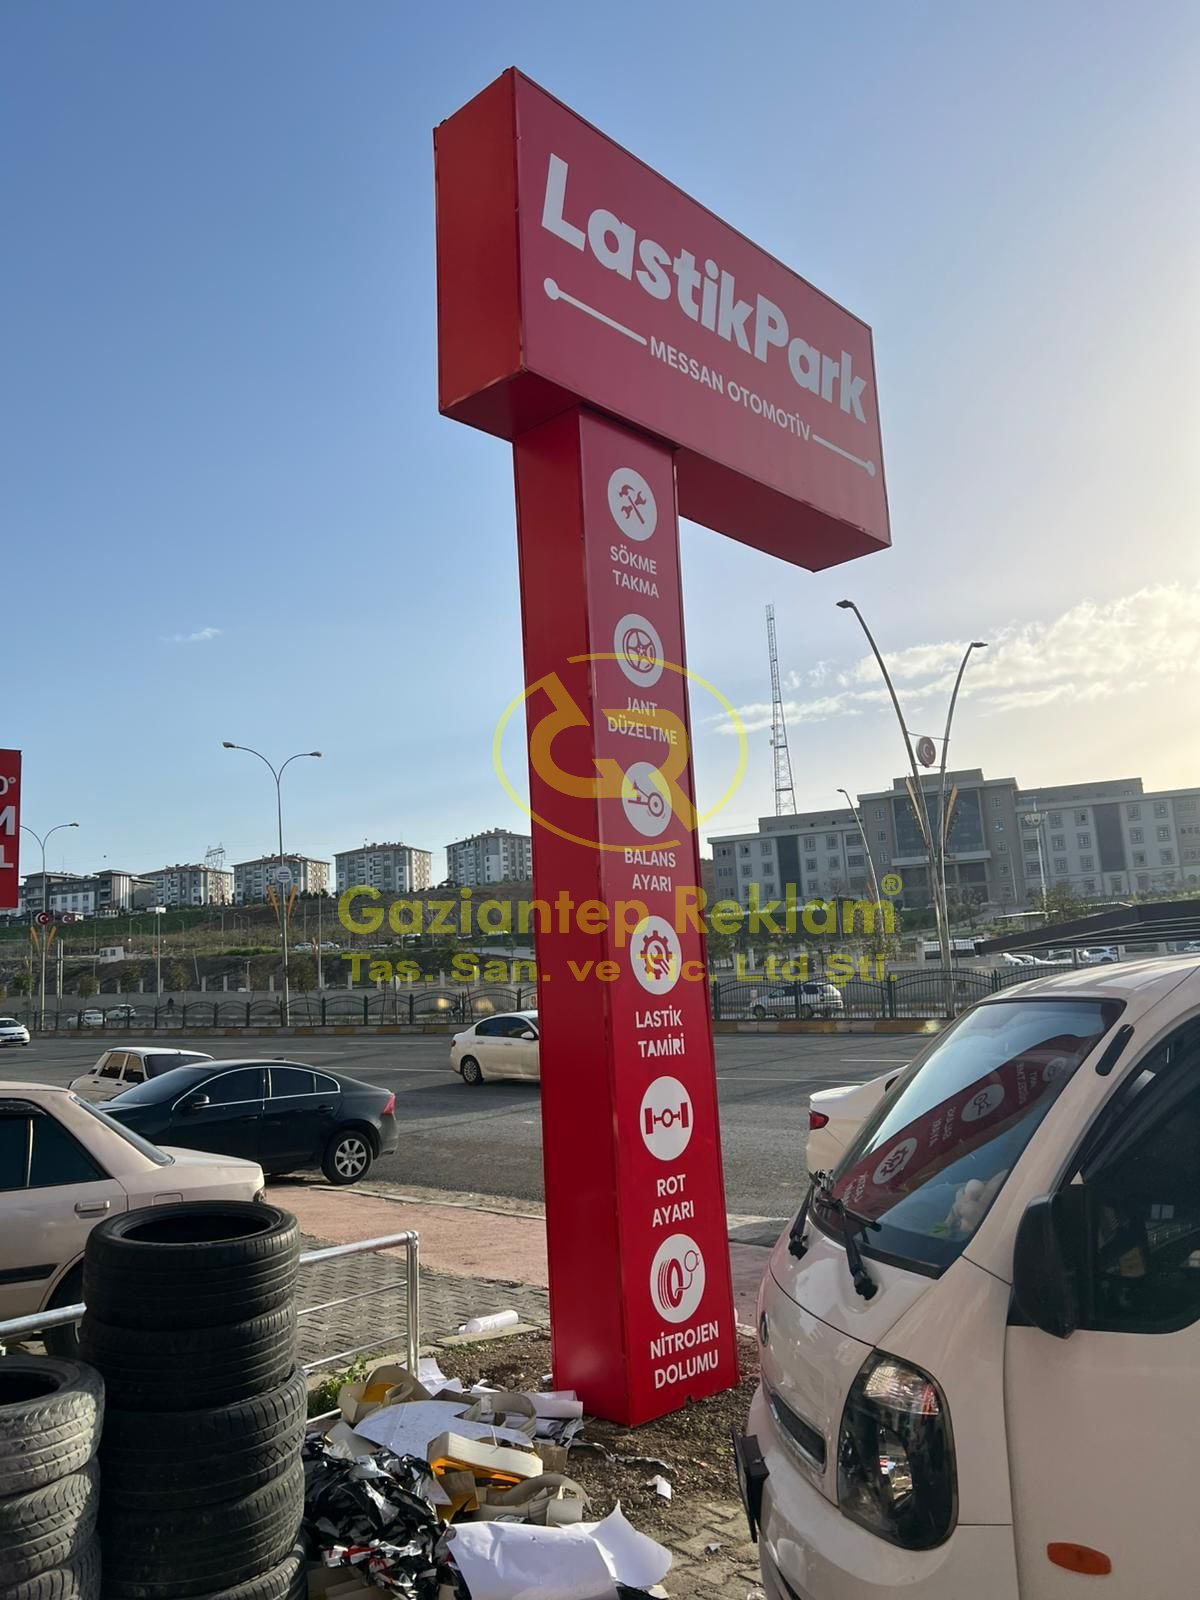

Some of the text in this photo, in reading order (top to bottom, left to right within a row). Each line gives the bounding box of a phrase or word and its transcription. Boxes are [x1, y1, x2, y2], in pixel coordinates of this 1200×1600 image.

[541, 152, 867, 424] LastikPark
[650, 335, 811, 441] MESSAN OTOMOTİV
[610, 545, 657, 575] SÖKME
[612, 570, 659, 599] TAKMA
[626, 697, 657, 718] JANT
[607, 715, 677, 745] DÜZELTME
[624, 847, 677, 868] BALANS
[632, 874, 672, 893] AYARI
[635, 1005, 683, 1028] LASTİK
[638, 1033, 685, 1058] TAMİRİ
[657, 1174, 686, 1197] ROT
[652, 1200, 694, 1227] AYARI
[650, 1320, 719, 1359] NİTROJEN
[655, 1349, 719, 1389] DOLUMU
